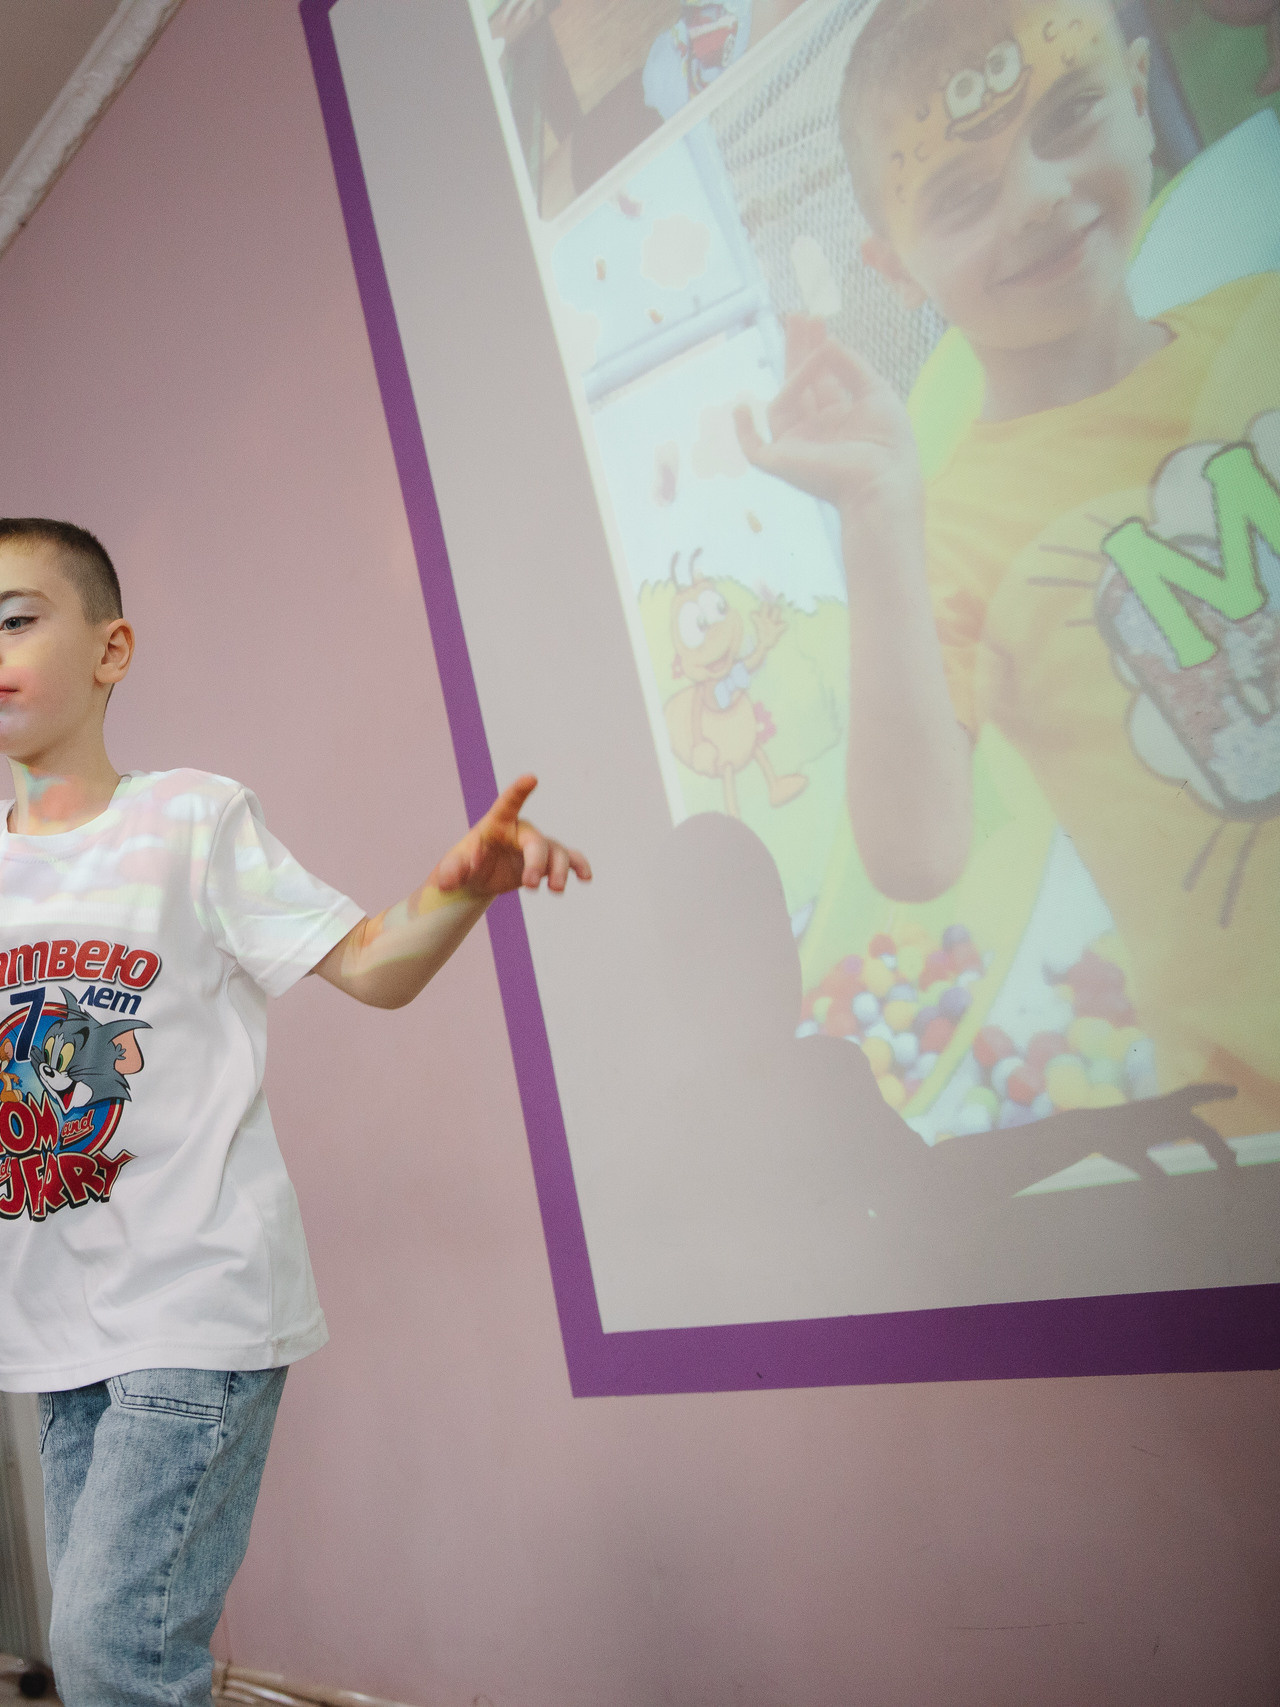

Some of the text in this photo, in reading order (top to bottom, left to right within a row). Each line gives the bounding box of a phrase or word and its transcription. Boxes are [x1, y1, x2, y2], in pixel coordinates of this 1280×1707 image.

[9, 984, 142, 1063] 7 лет
[60, 1109, 95, 1144] and
